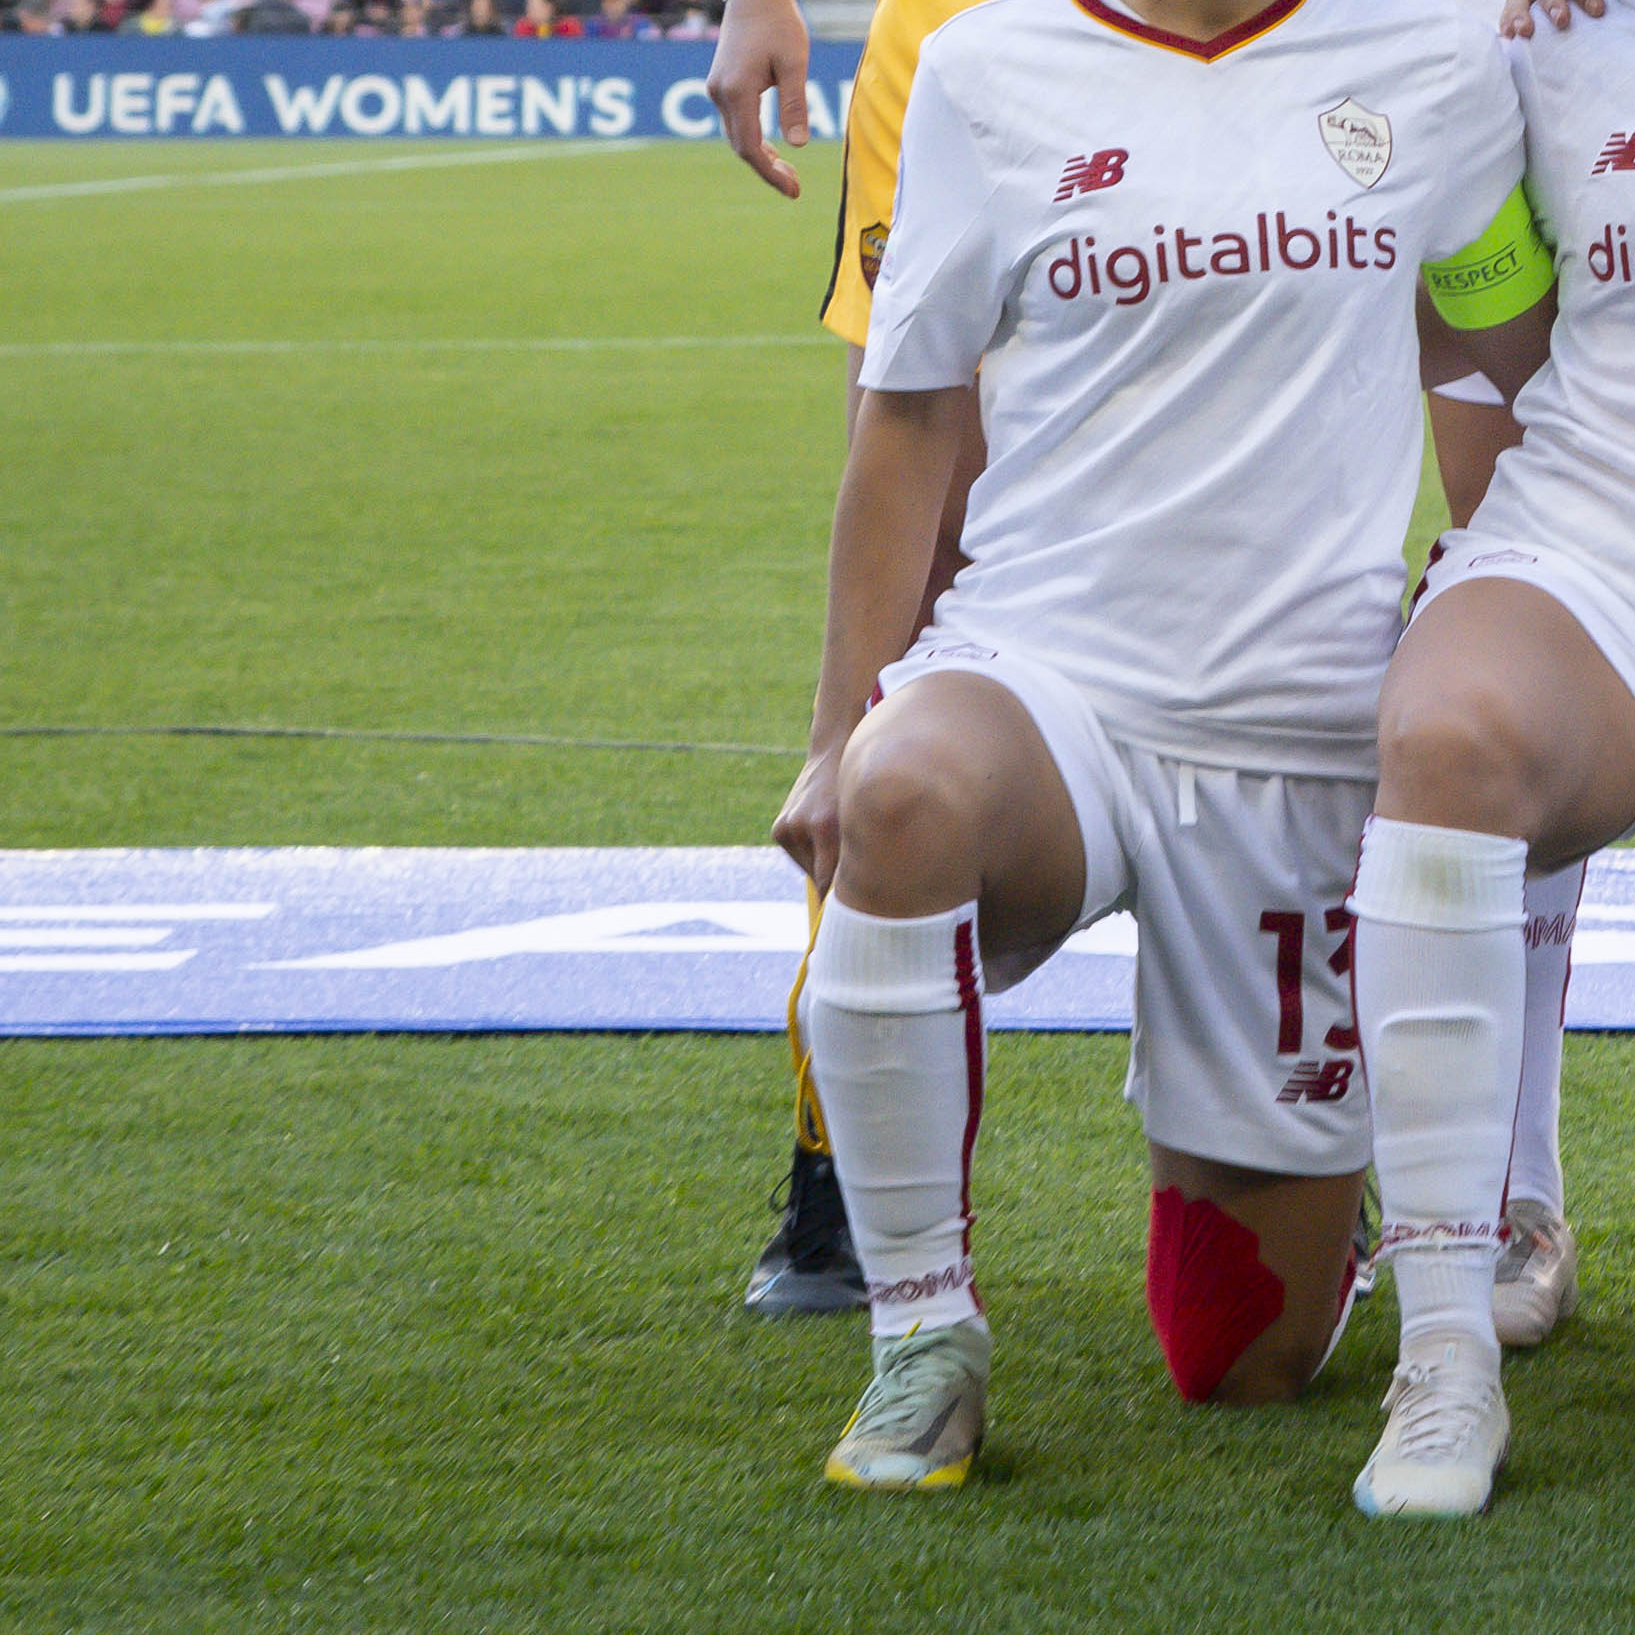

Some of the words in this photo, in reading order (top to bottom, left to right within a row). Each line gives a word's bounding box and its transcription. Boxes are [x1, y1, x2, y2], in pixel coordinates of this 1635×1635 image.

[53, 73, 244, 135] UEFA
[263, 75, 636, 136] WOMEN'S
[1048, 210, 1397, 306] digitalbits
[1430, 248, 1518, 289] RESPECT
